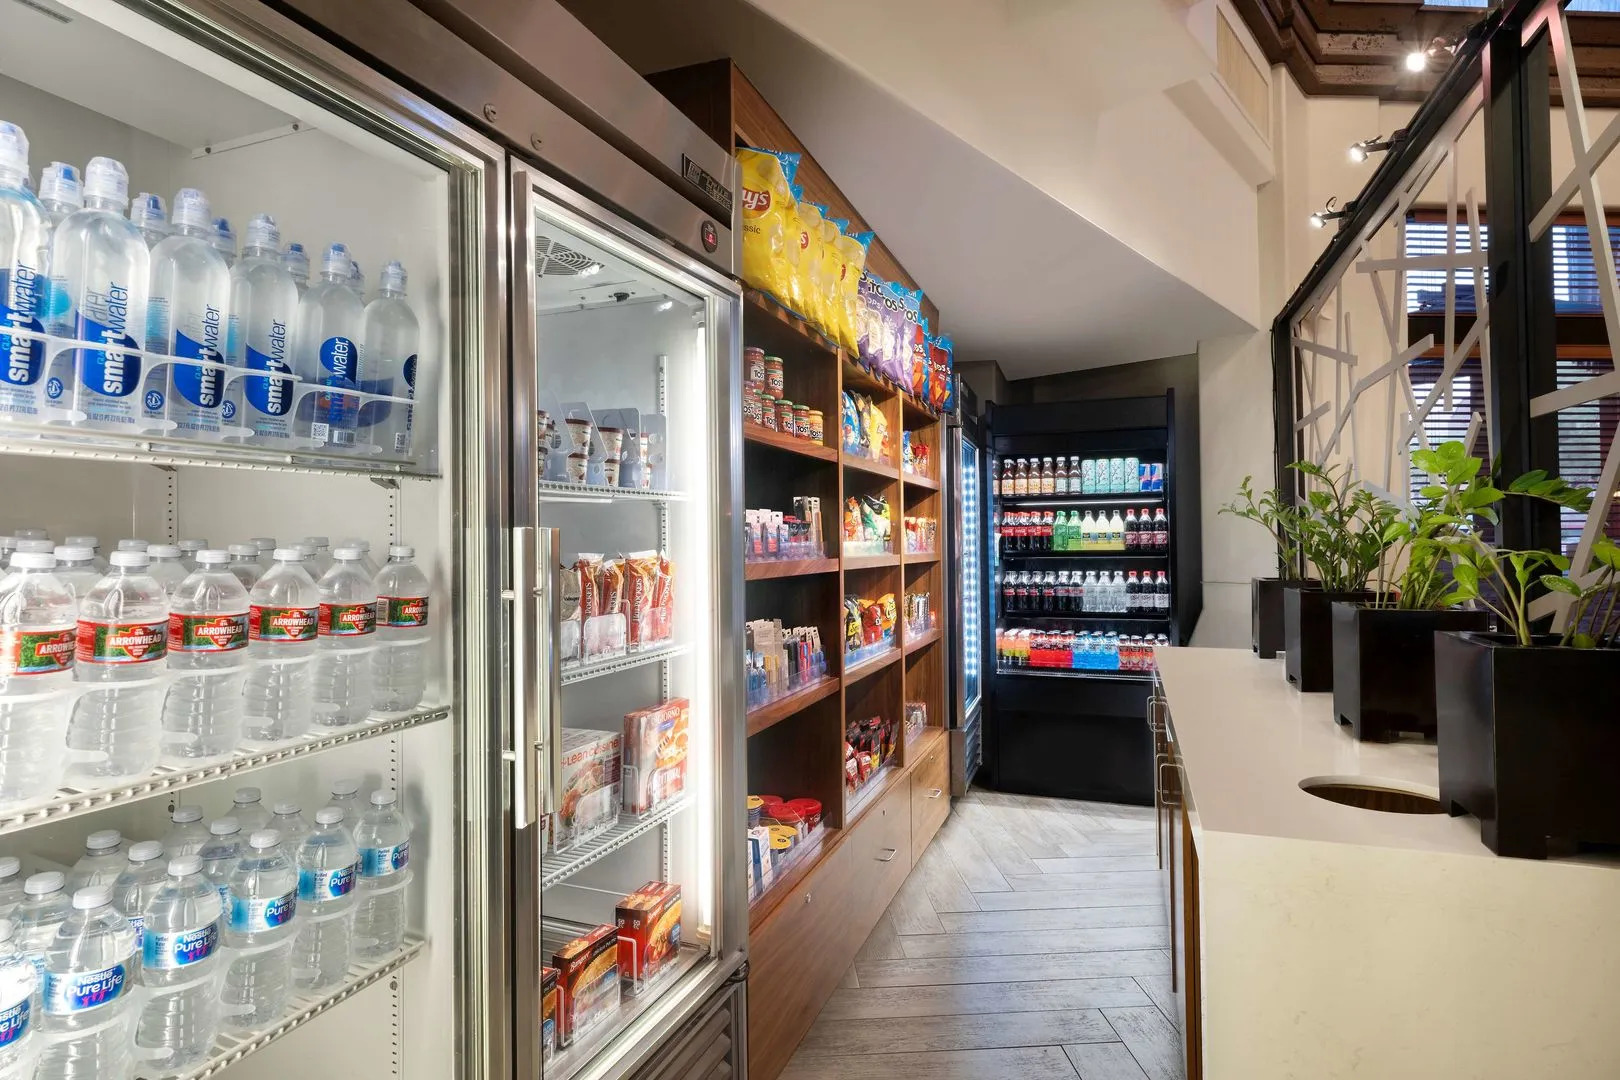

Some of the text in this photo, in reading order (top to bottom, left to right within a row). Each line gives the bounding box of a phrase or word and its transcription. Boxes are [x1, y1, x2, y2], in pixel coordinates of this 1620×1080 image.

[197, 624, 243, 636] ARROWHEAD
[110, 634, 162, 646] ARROWHEAD
[174, 939, 203, 954] Pure
[67, 974, 124, 1000] Pure Life
